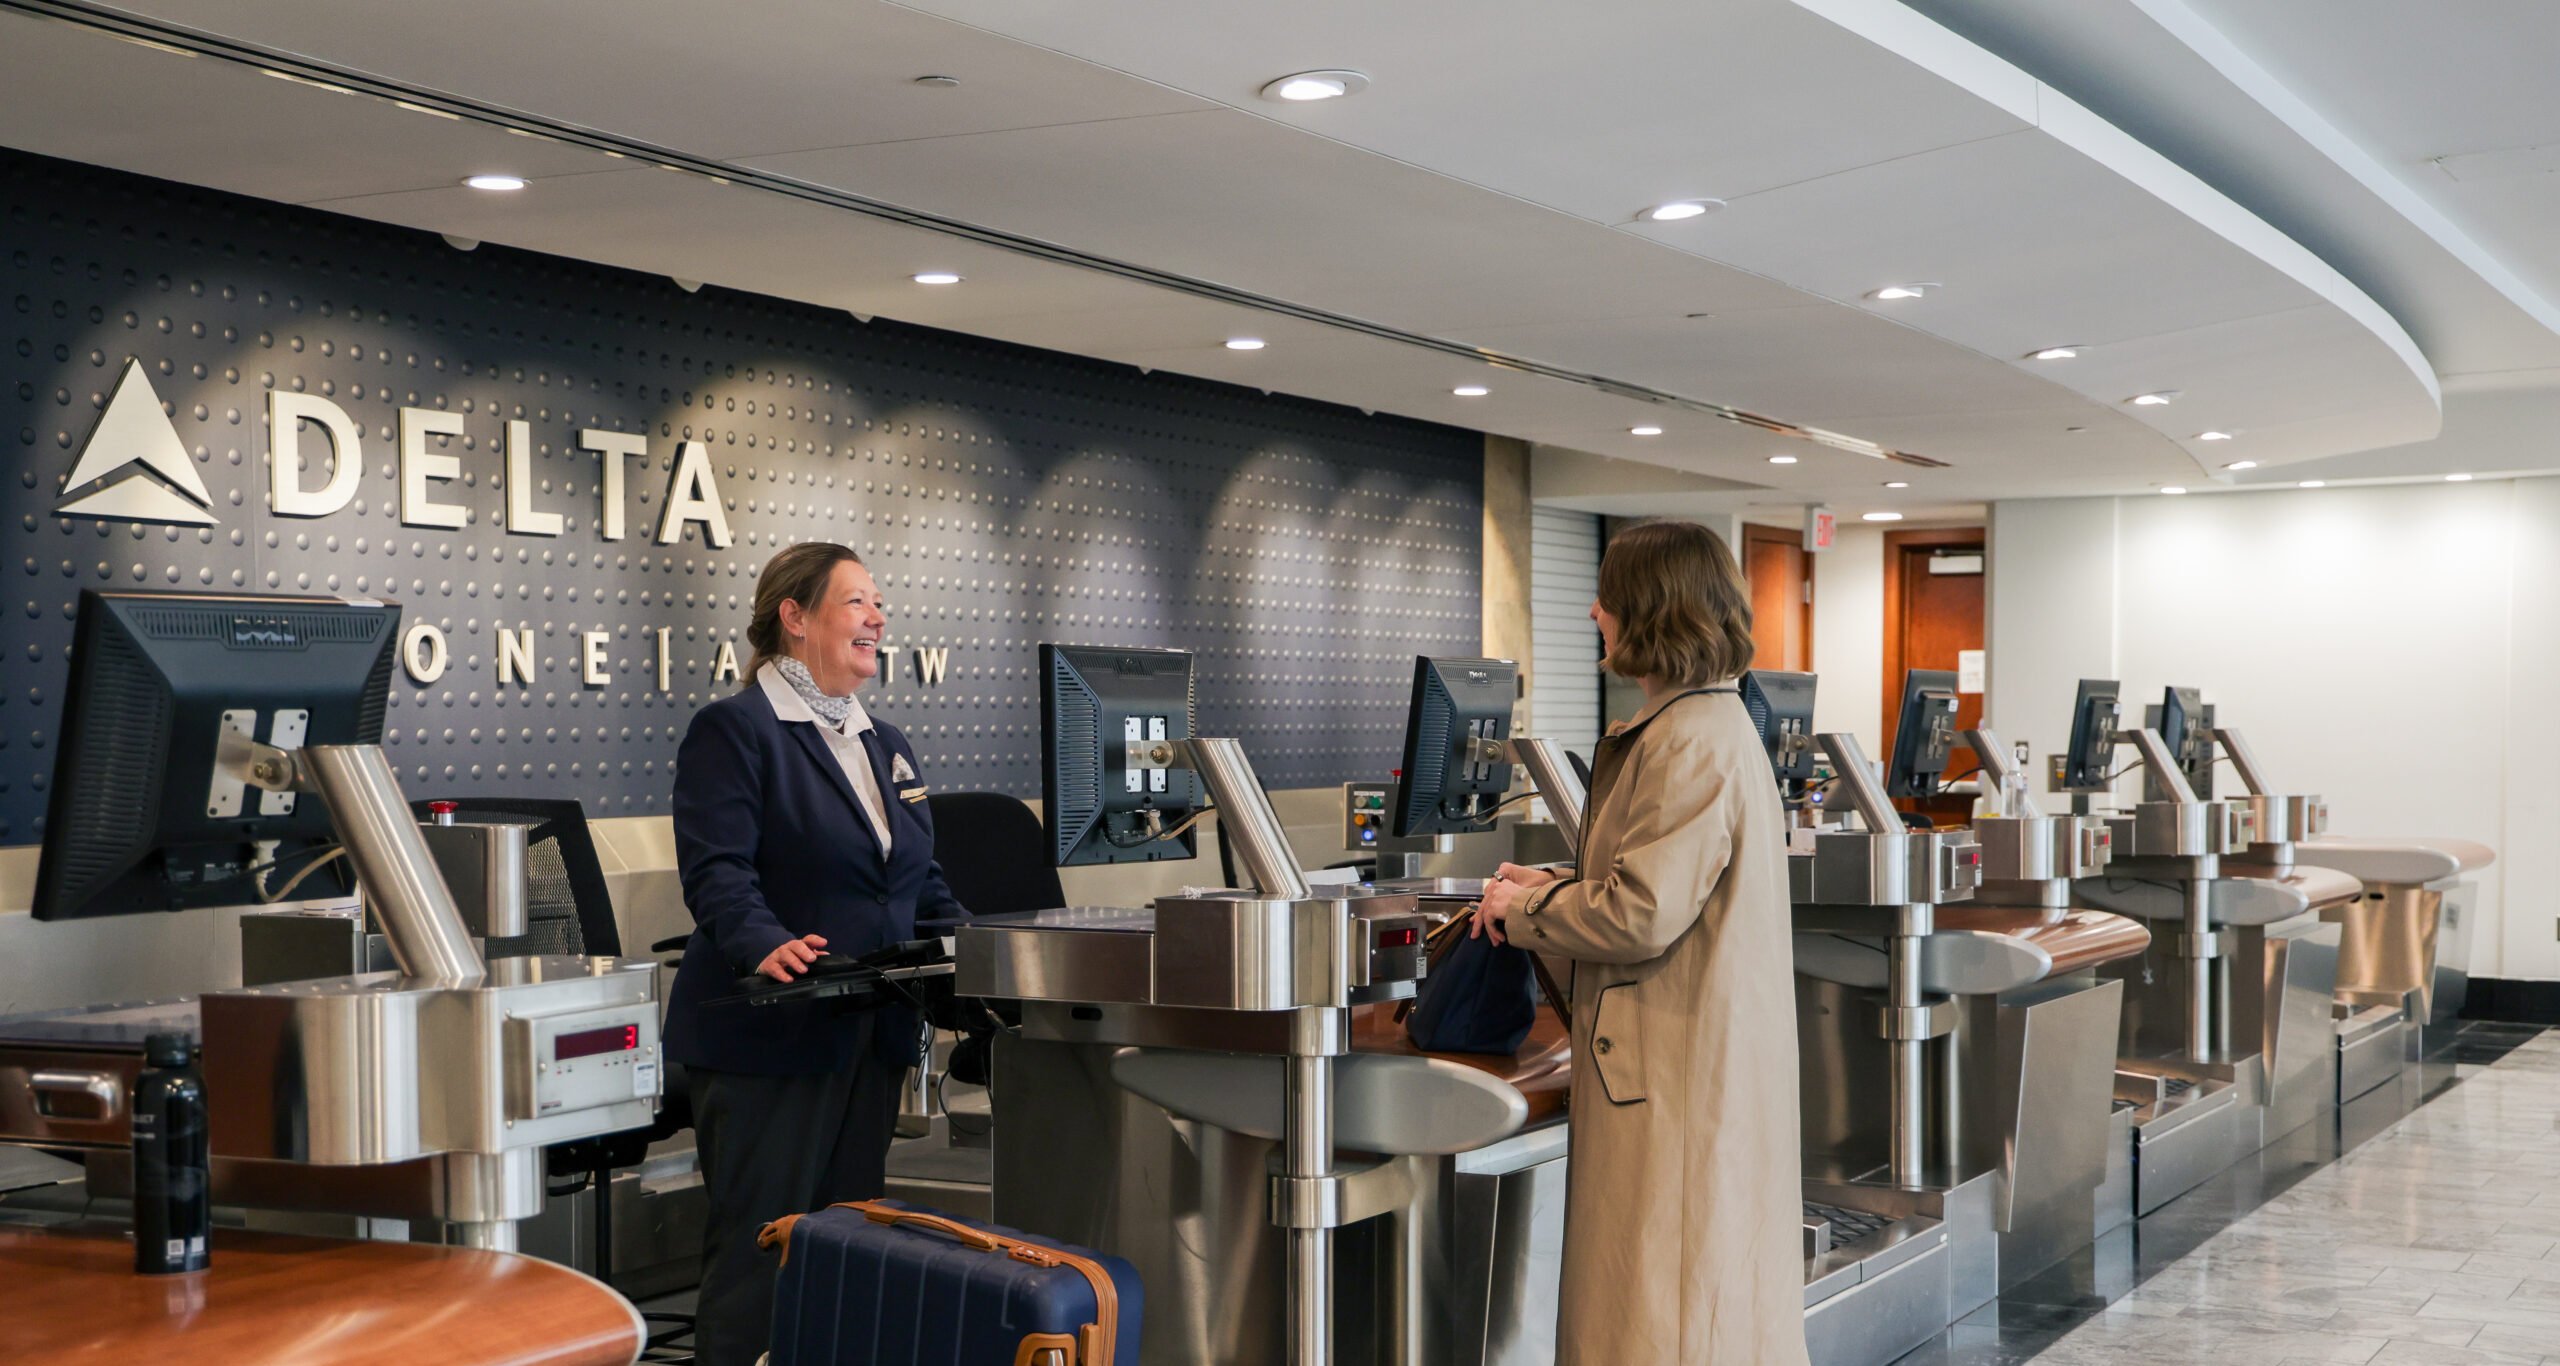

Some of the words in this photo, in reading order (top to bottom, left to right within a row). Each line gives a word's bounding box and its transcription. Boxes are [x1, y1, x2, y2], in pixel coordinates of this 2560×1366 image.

[269, 390, 732, 549] DELTA
[403, 624, 611, 685] ONE
[624, 1025, 637, 1050] 3
